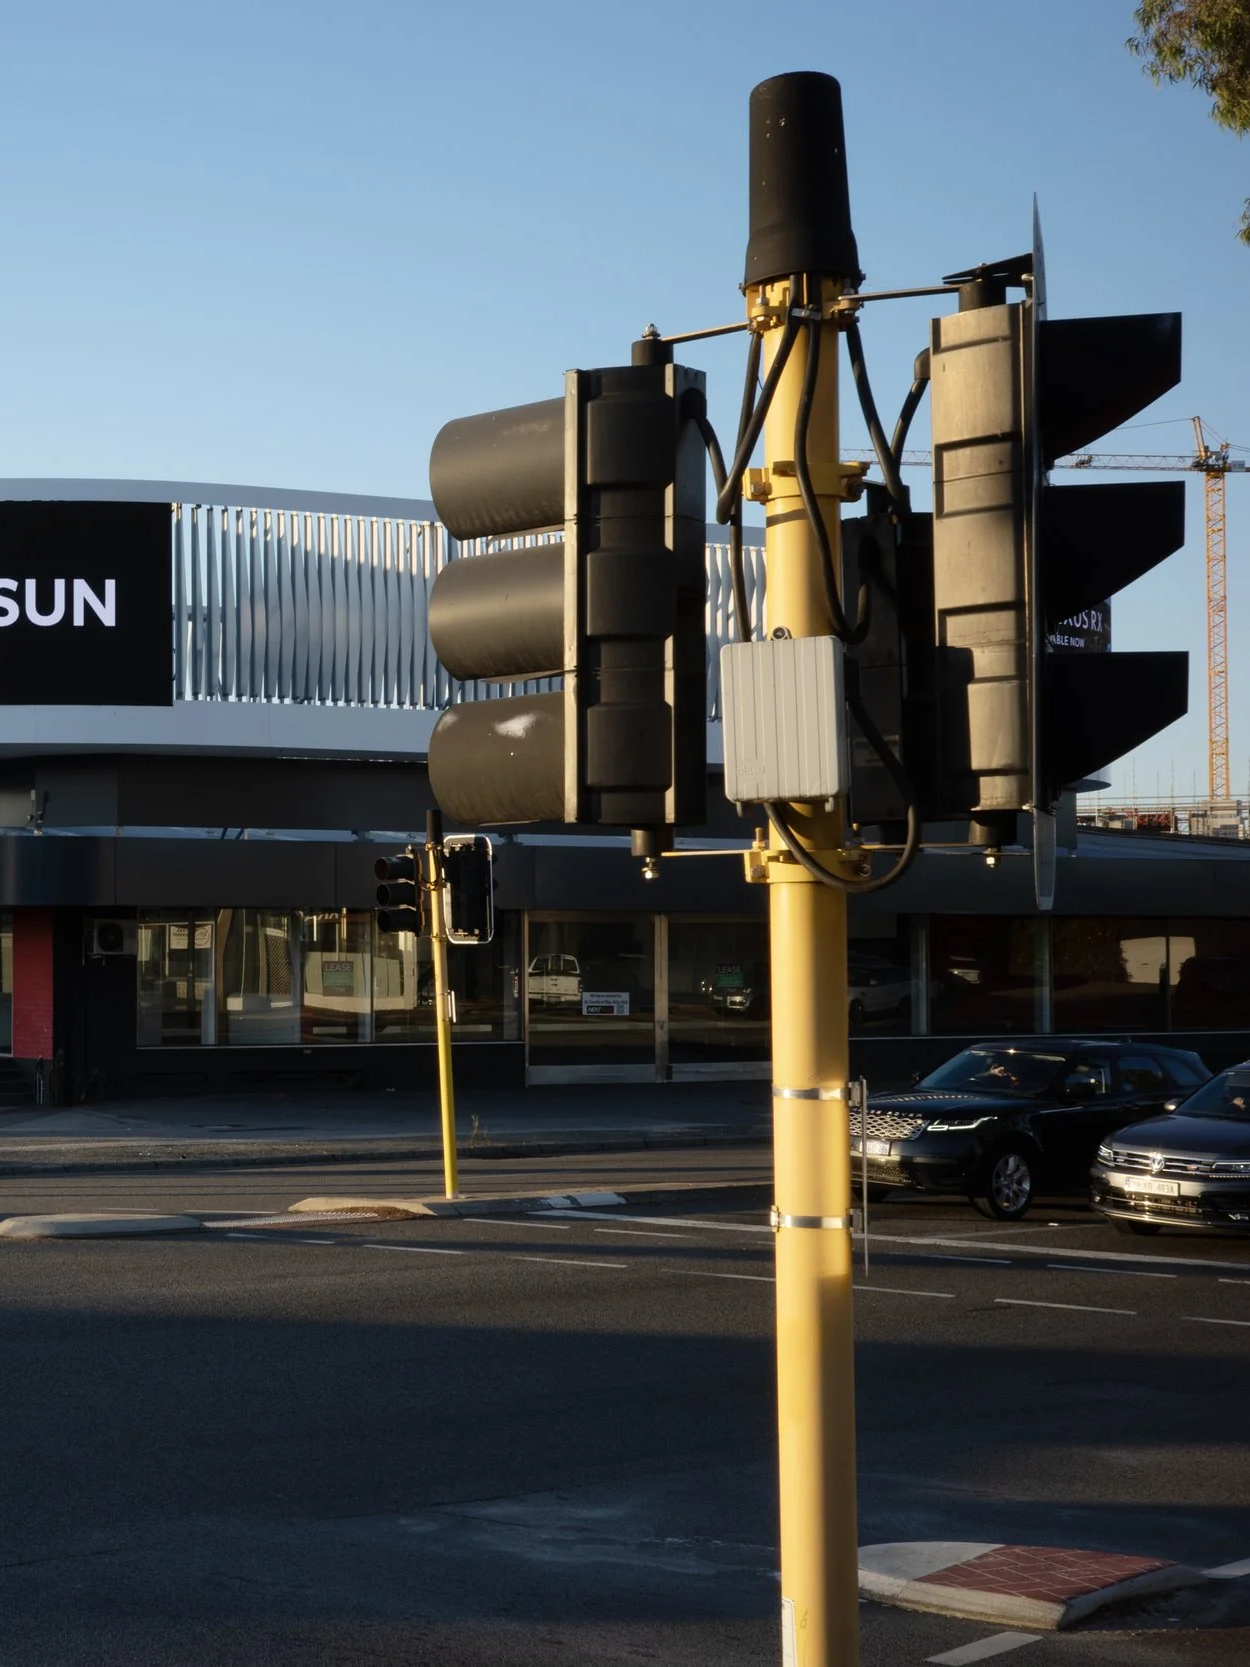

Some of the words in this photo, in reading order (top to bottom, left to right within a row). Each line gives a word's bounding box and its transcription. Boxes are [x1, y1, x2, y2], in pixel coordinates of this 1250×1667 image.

[1090, 610, 1103, 632] RX
[1070, 636, 1085, 648] NOW
[325, 963, 351, 972] LEASE
[717, 965, 742, 974] LEASE
